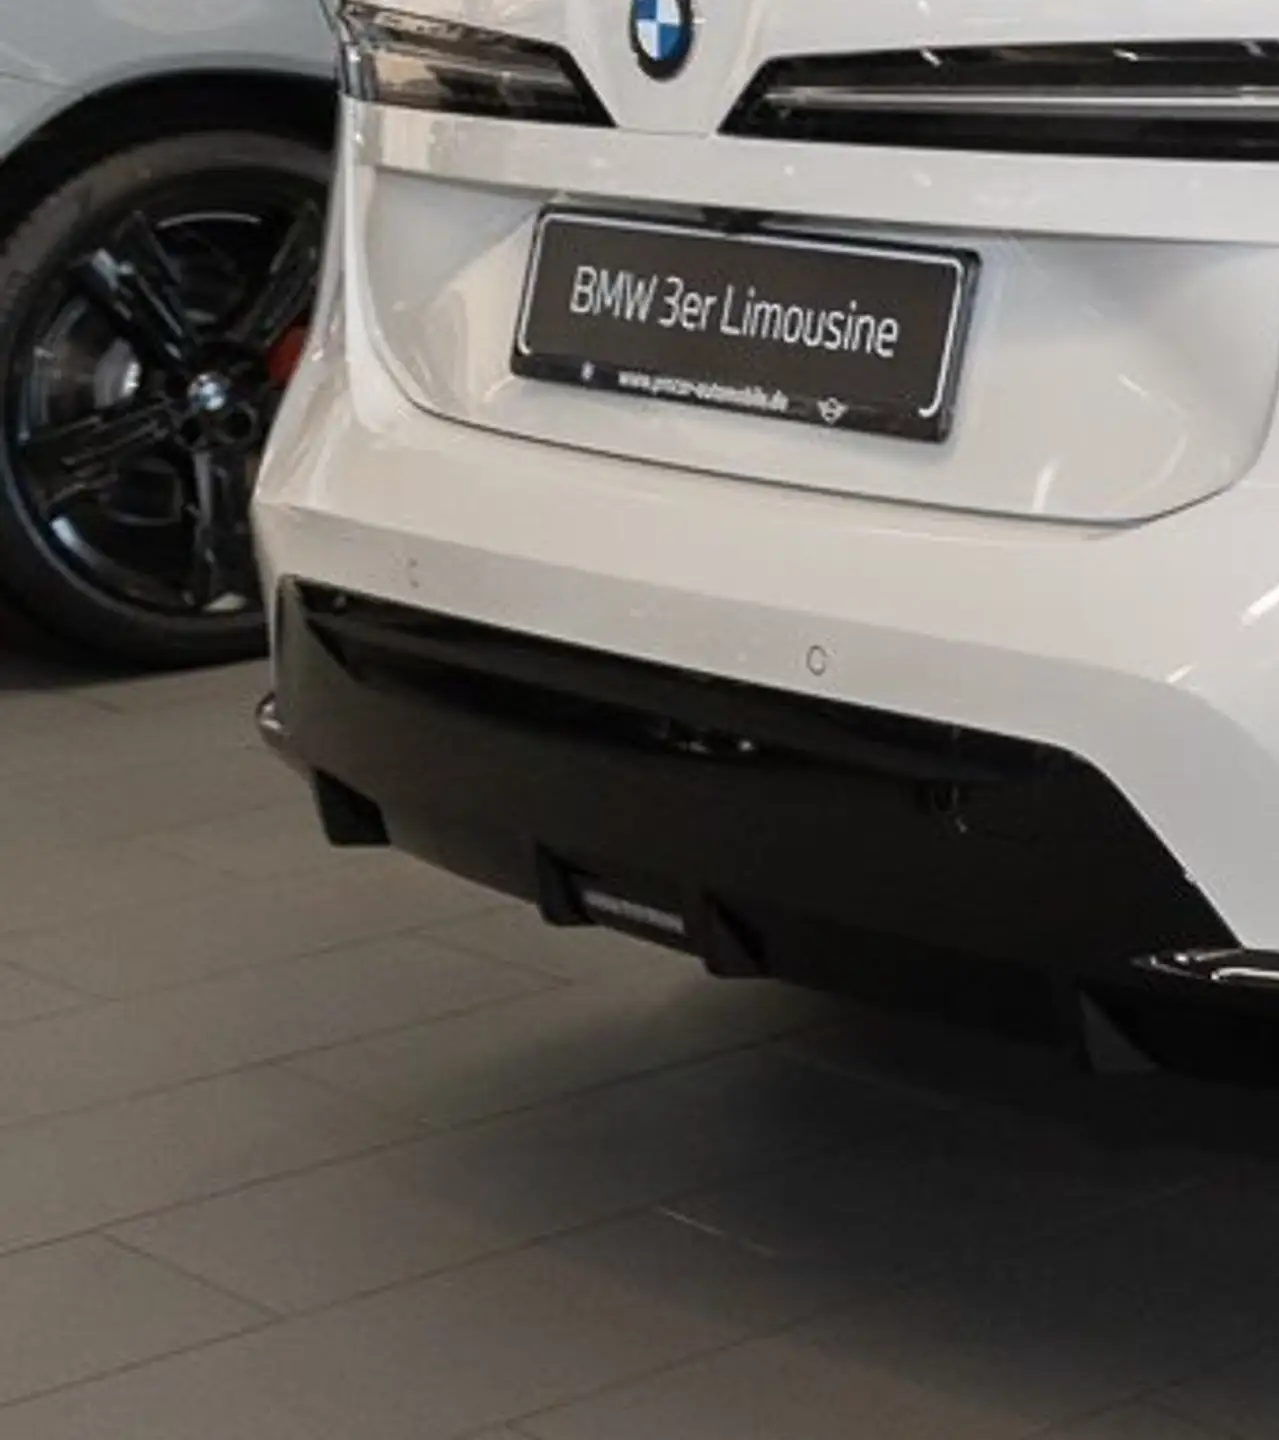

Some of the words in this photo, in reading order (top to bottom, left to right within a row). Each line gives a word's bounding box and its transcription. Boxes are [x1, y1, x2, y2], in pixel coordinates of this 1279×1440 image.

[568, 264, 659, 324] BMW
[657, 275, 717, 331] 3er
[719, 283, 900, 359] Limousine
